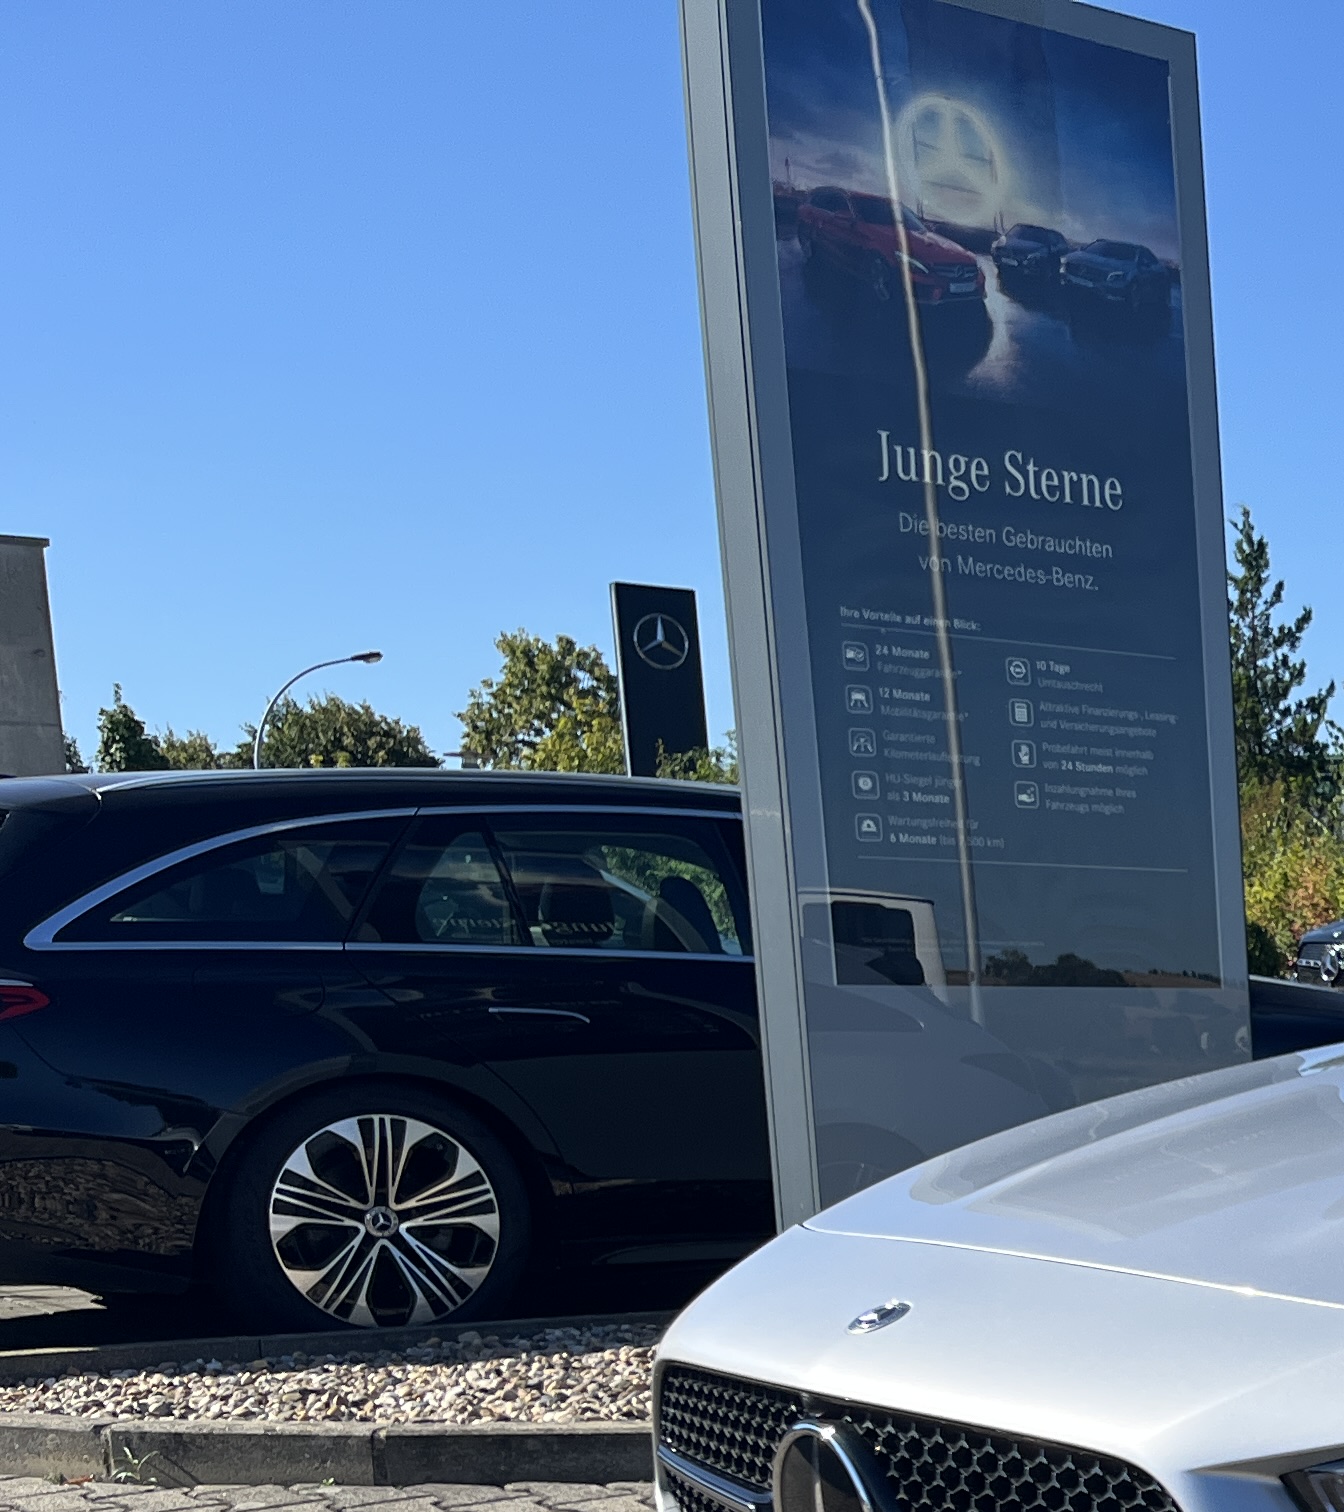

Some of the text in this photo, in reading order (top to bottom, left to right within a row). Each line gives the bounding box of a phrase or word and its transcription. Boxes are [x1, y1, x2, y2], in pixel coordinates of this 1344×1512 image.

[877, 429, 1125, 511] Junge Sterne
[899, 512, 1113, 559] Die besten Gebrauchten
[919, 555, 1099, 590] von Mercedes-Benz.
[875, 644, 929, 660] 24 Monate
[1036, 661, 1071, 675] 10 Tage
[878, 687, 931, 702] 12 Monate
[1061, 760, 1073, 771] 24
[1075, 761, 1114, 774] Stunden
[902, 790, 910, 802] 3
[912, 791, 950, 804] Monate
[889, 833, 897, 844] 6
[899, 833, 937, 845] Monate
